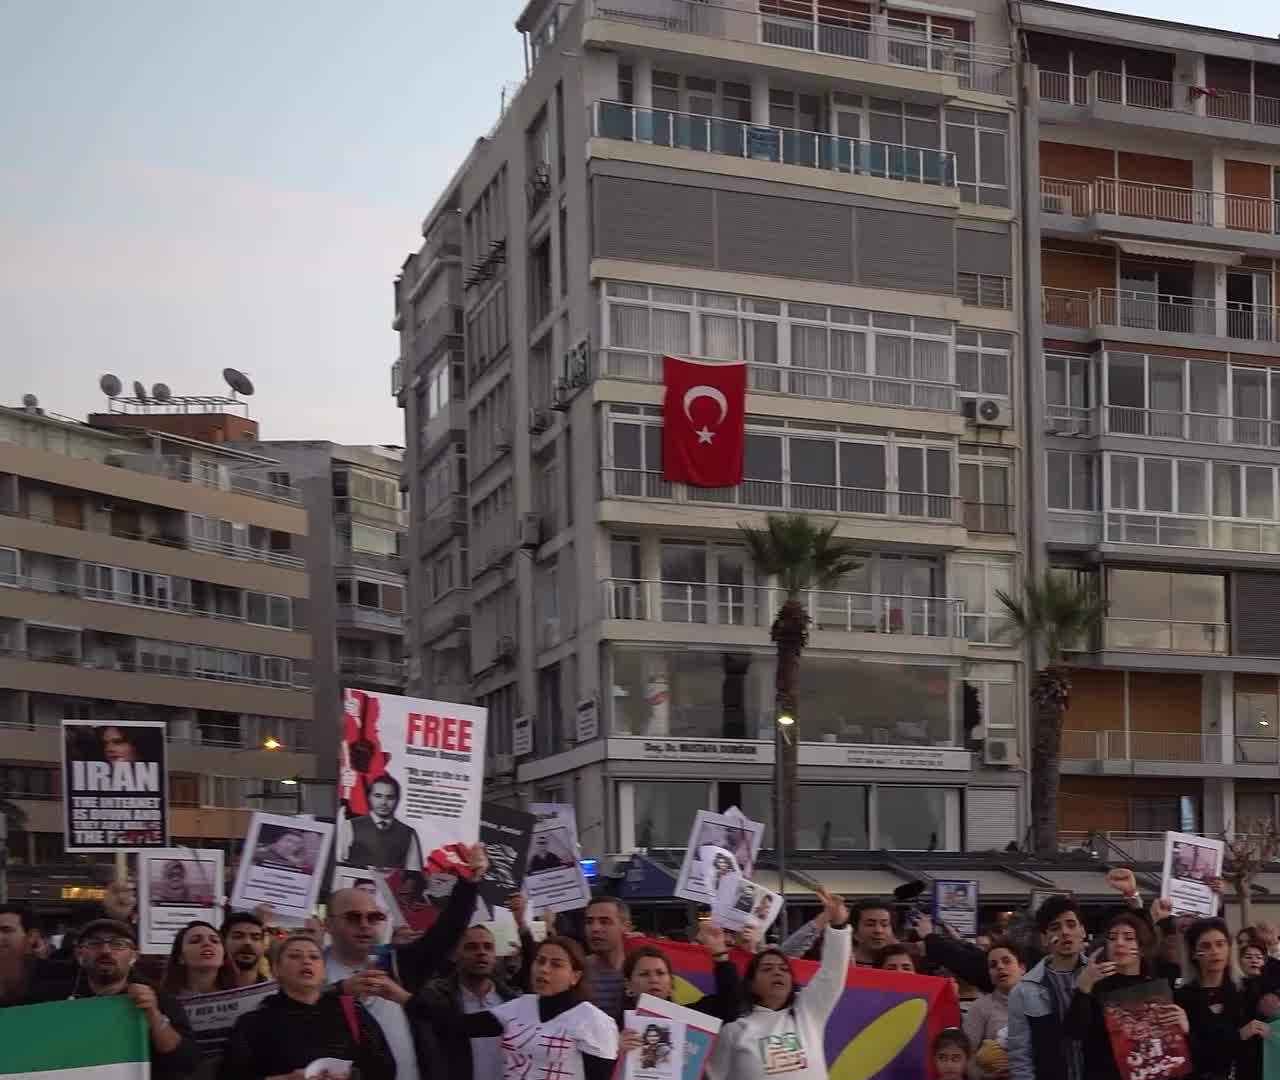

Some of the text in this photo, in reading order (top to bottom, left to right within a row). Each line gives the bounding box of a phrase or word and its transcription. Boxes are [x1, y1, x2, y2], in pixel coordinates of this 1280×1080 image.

[406, 712, 473, 752] FREE
[72, 760, 160, 792] IRAN
[74, 831, 104, 844] THE
